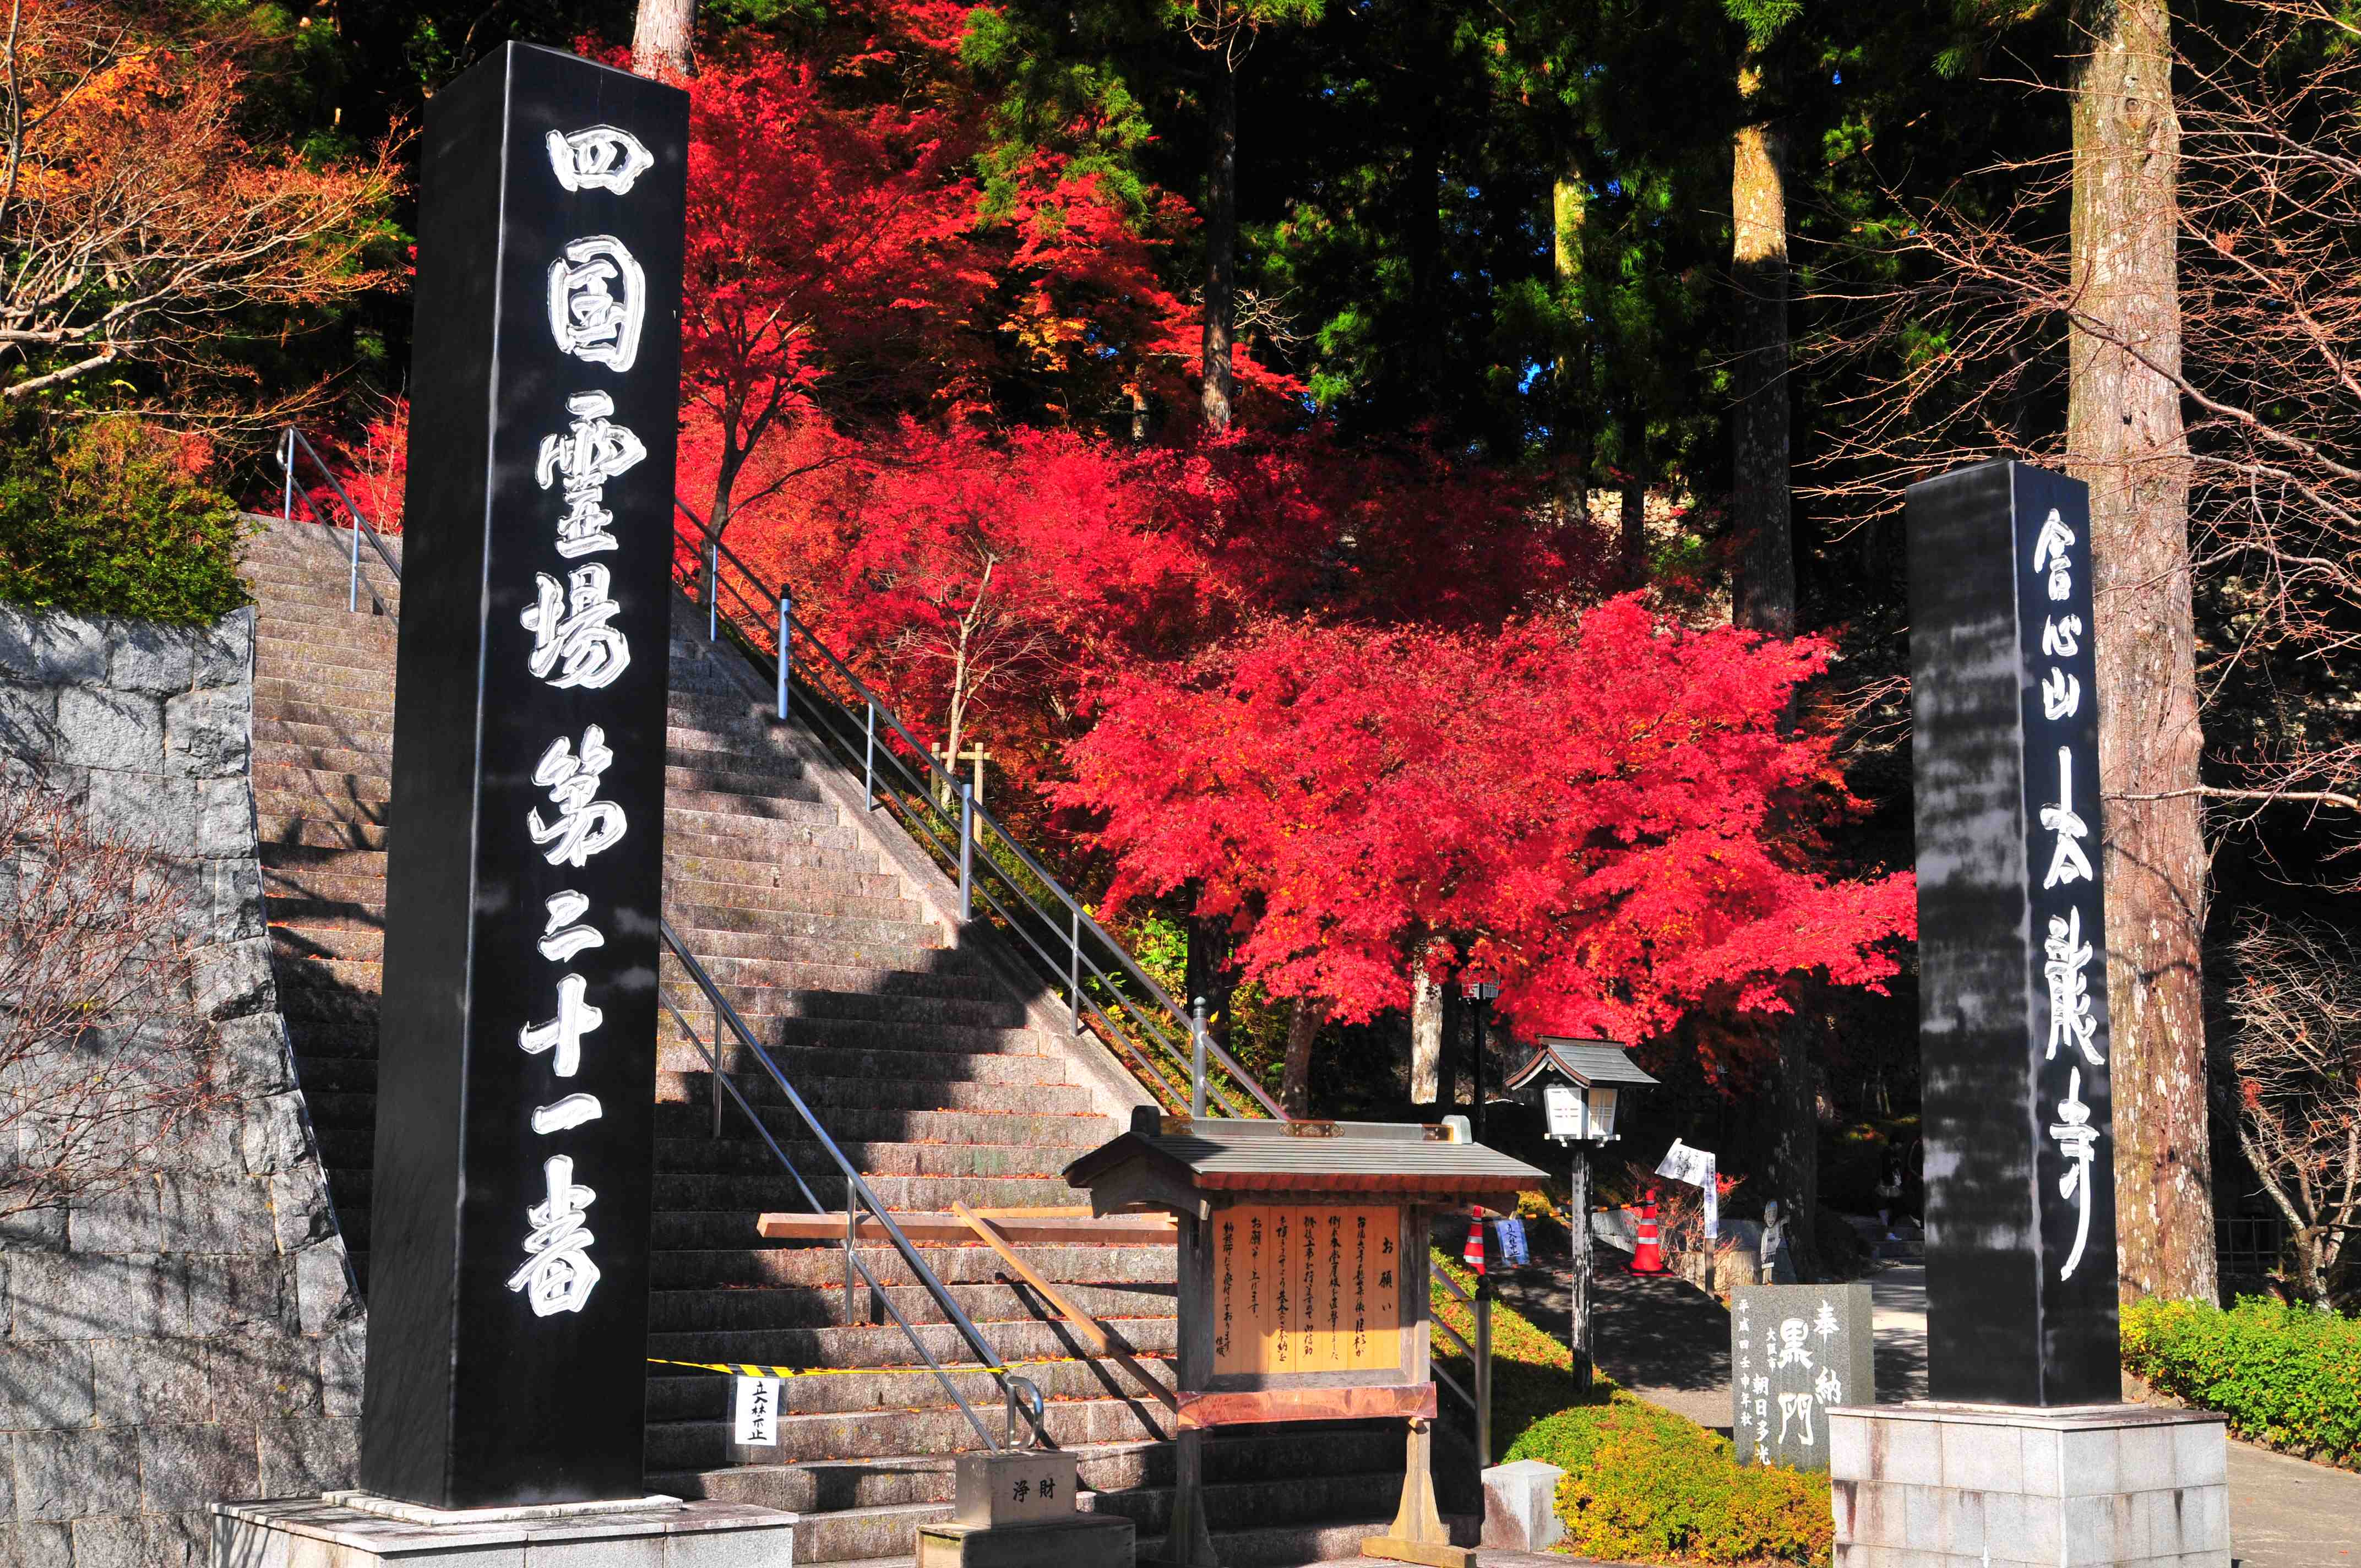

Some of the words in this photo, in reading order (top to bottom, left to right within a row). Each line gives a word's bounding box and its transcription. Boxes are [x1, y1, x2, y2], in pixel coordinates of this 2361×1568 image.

[1379, 1237, 1394, 1311] お願い
[1738, 1299, 1753, 1427] 平成四壬申年秋
[1766, 1327, 1777, 1373] 大阪市
[1777, 1317, 1814, 1446] 黒門
[1813, 1299, 1842, 1404] 奉納
[747, 1380, 768, 1440] 立入禁止
[1013, 1478, 1056, 1502] 浄財
